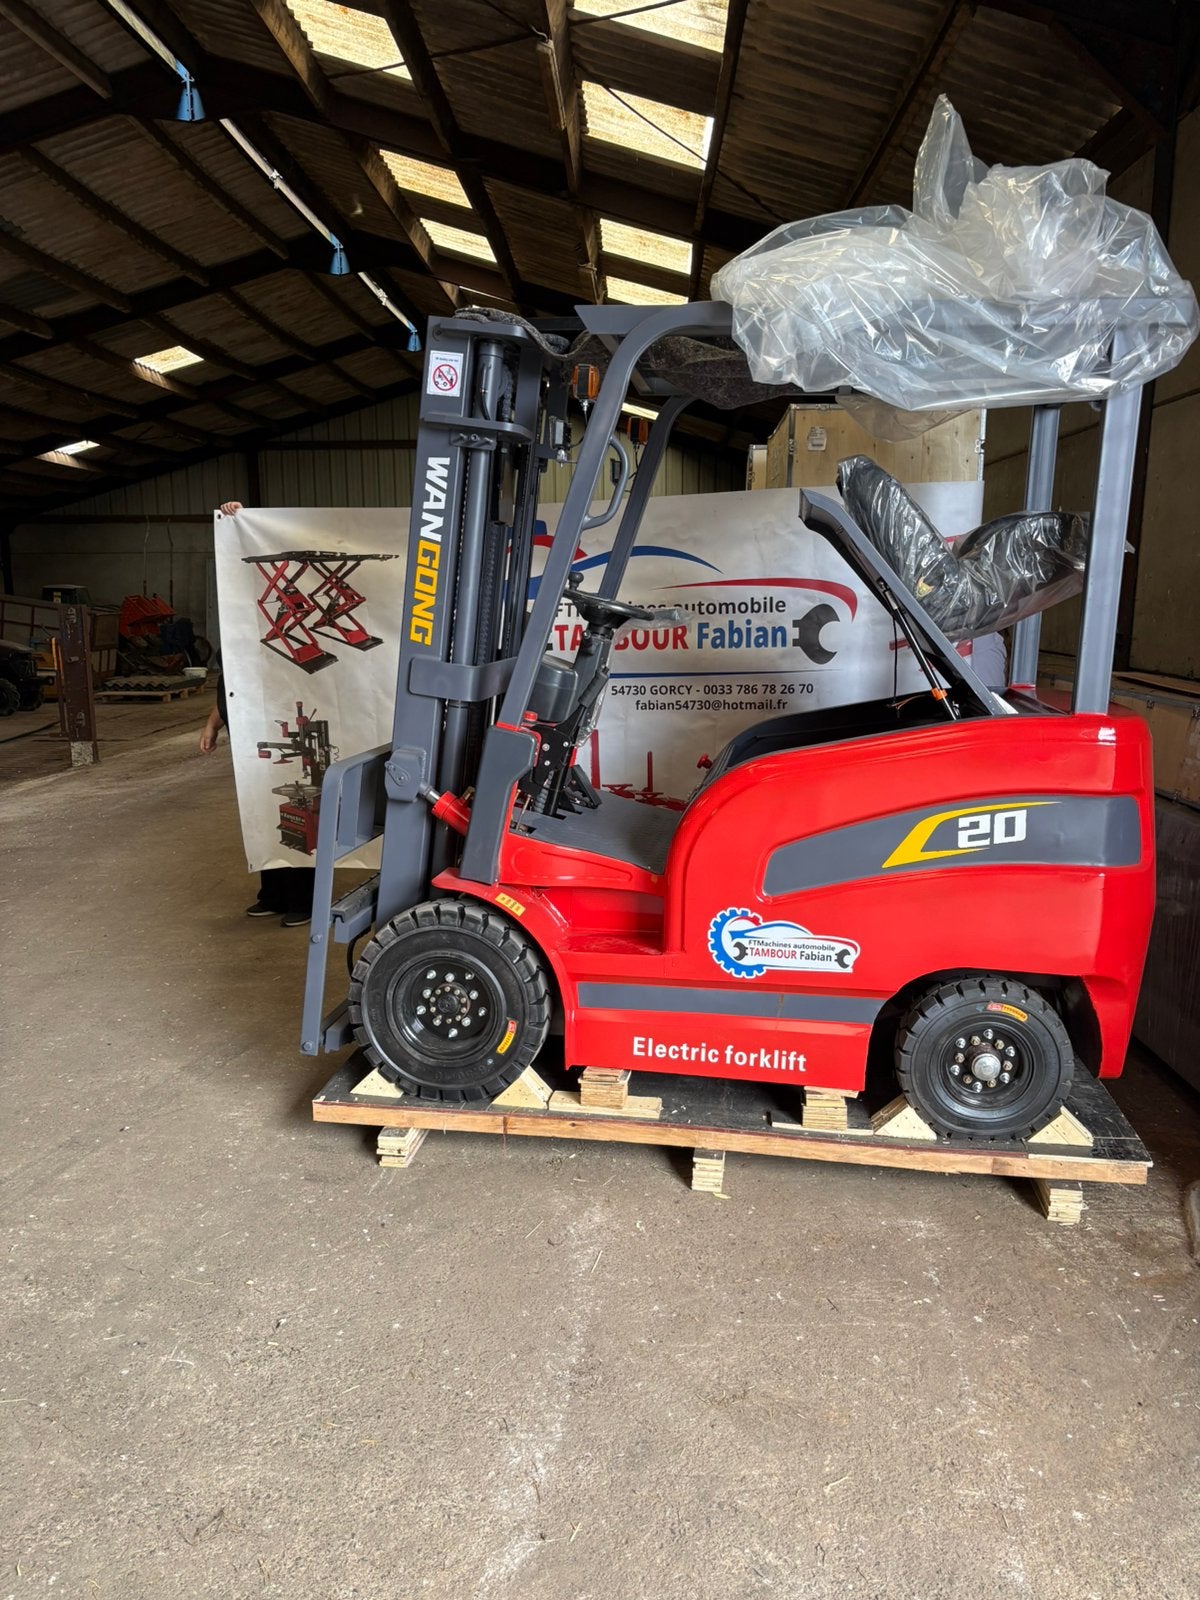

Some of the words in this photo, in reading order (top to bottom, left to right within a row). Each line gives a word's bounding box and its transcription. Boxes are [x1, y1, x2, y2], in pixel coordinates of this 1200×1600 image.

[409, 456, 451, 646] WANGONG
[674, 596, 786, 615] utomobile
[554, 624, 690, 651] TABOUR
[697, 618, 788, 650] Fabian
[611, 685, 646, 696] 54730
[650, 684, 693, 696] GORCY
[703, 684, 733, 695] 0033
[736, 684, 758, 695] 786
[762, 683, 778, 695] 78
[780, 683, 795, 694] 26
[798, 683, 814, 694] 70
[635, 699, 788, 711] fabian54730@hotmail.fr
[958, 809, 1027, 848] 20
[748, 939, 792, 948] FTMachines
[793, 943, 836, 952] automobile
[749, 947, 798, 959] TAMBOUR
[799, 950, 832, 962] Fabian
[633, 1036, 720, 1063] Electric
[724, 1045, 807, 1072] forklift
